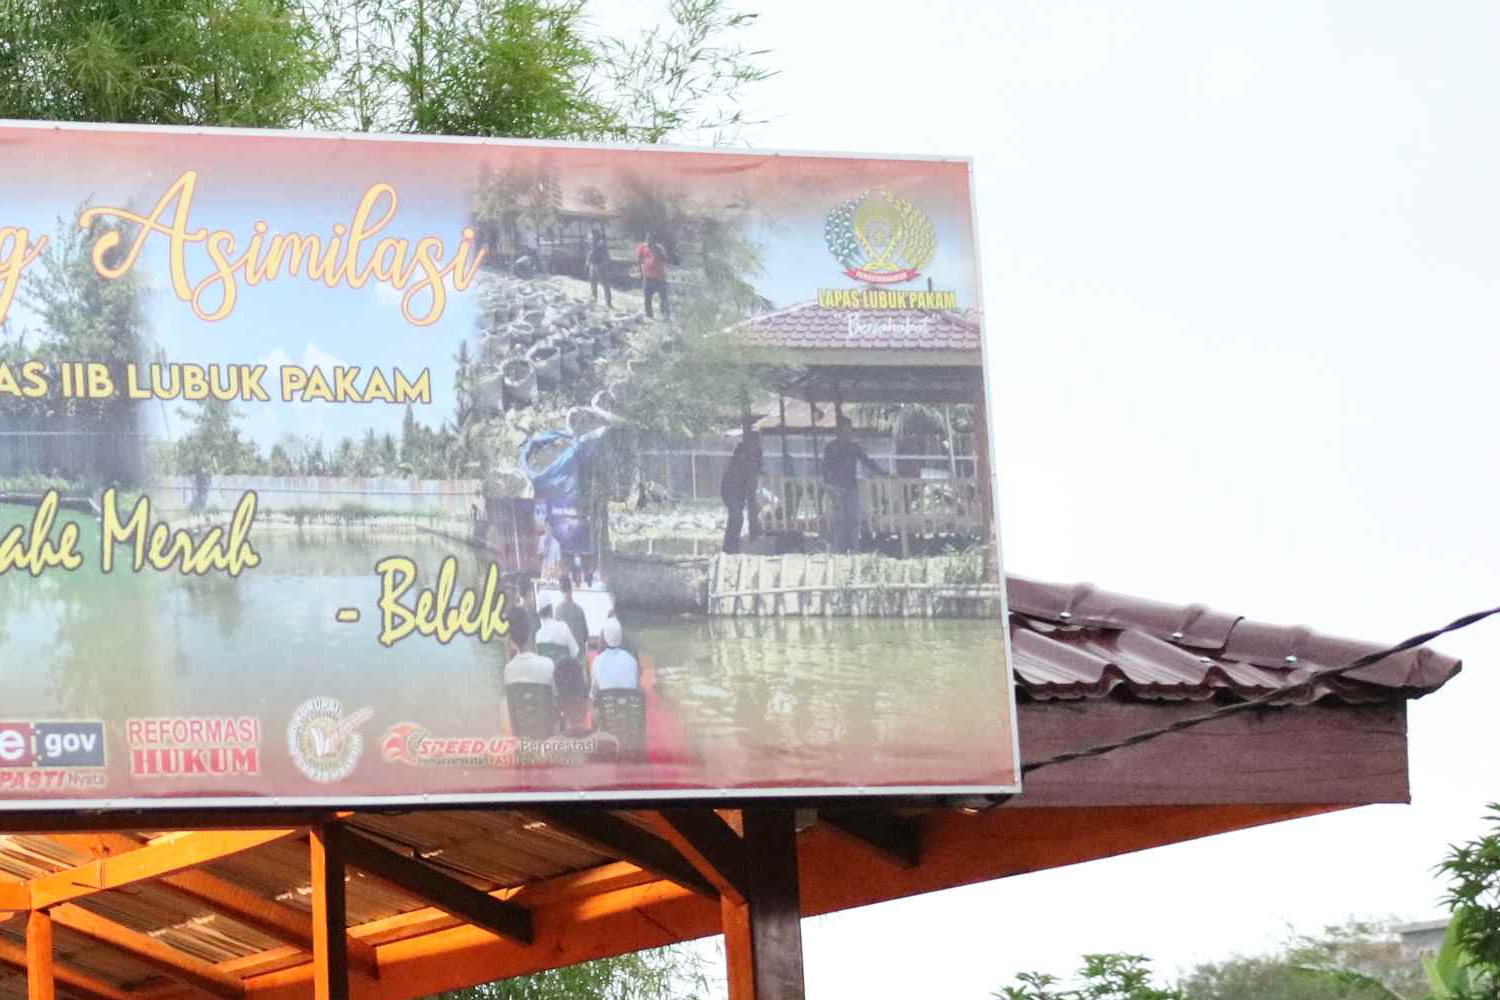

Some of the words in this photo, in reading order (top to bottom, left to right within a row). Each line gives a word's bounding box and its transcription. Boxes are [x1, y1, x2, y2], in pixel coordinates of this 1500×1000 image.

[77, 169, 487, 327] Asimilasi
[819, 289, 860, 309] LAPAS
[863, 290, 908, 310] LUBUK
[909, 291, 957, 310] PAKAM
[60, 361, 115, 398] IIB
[127, 363, 270, 401] LUBUK
[280, 366, 432, 404] PAKAM
[101, 488, 262, 577] Merah
[129, 720, 259, 743] REFORMASI
[133, 749, 257, 774] HUKUM
[0, 771, 67, 787] PASTI
